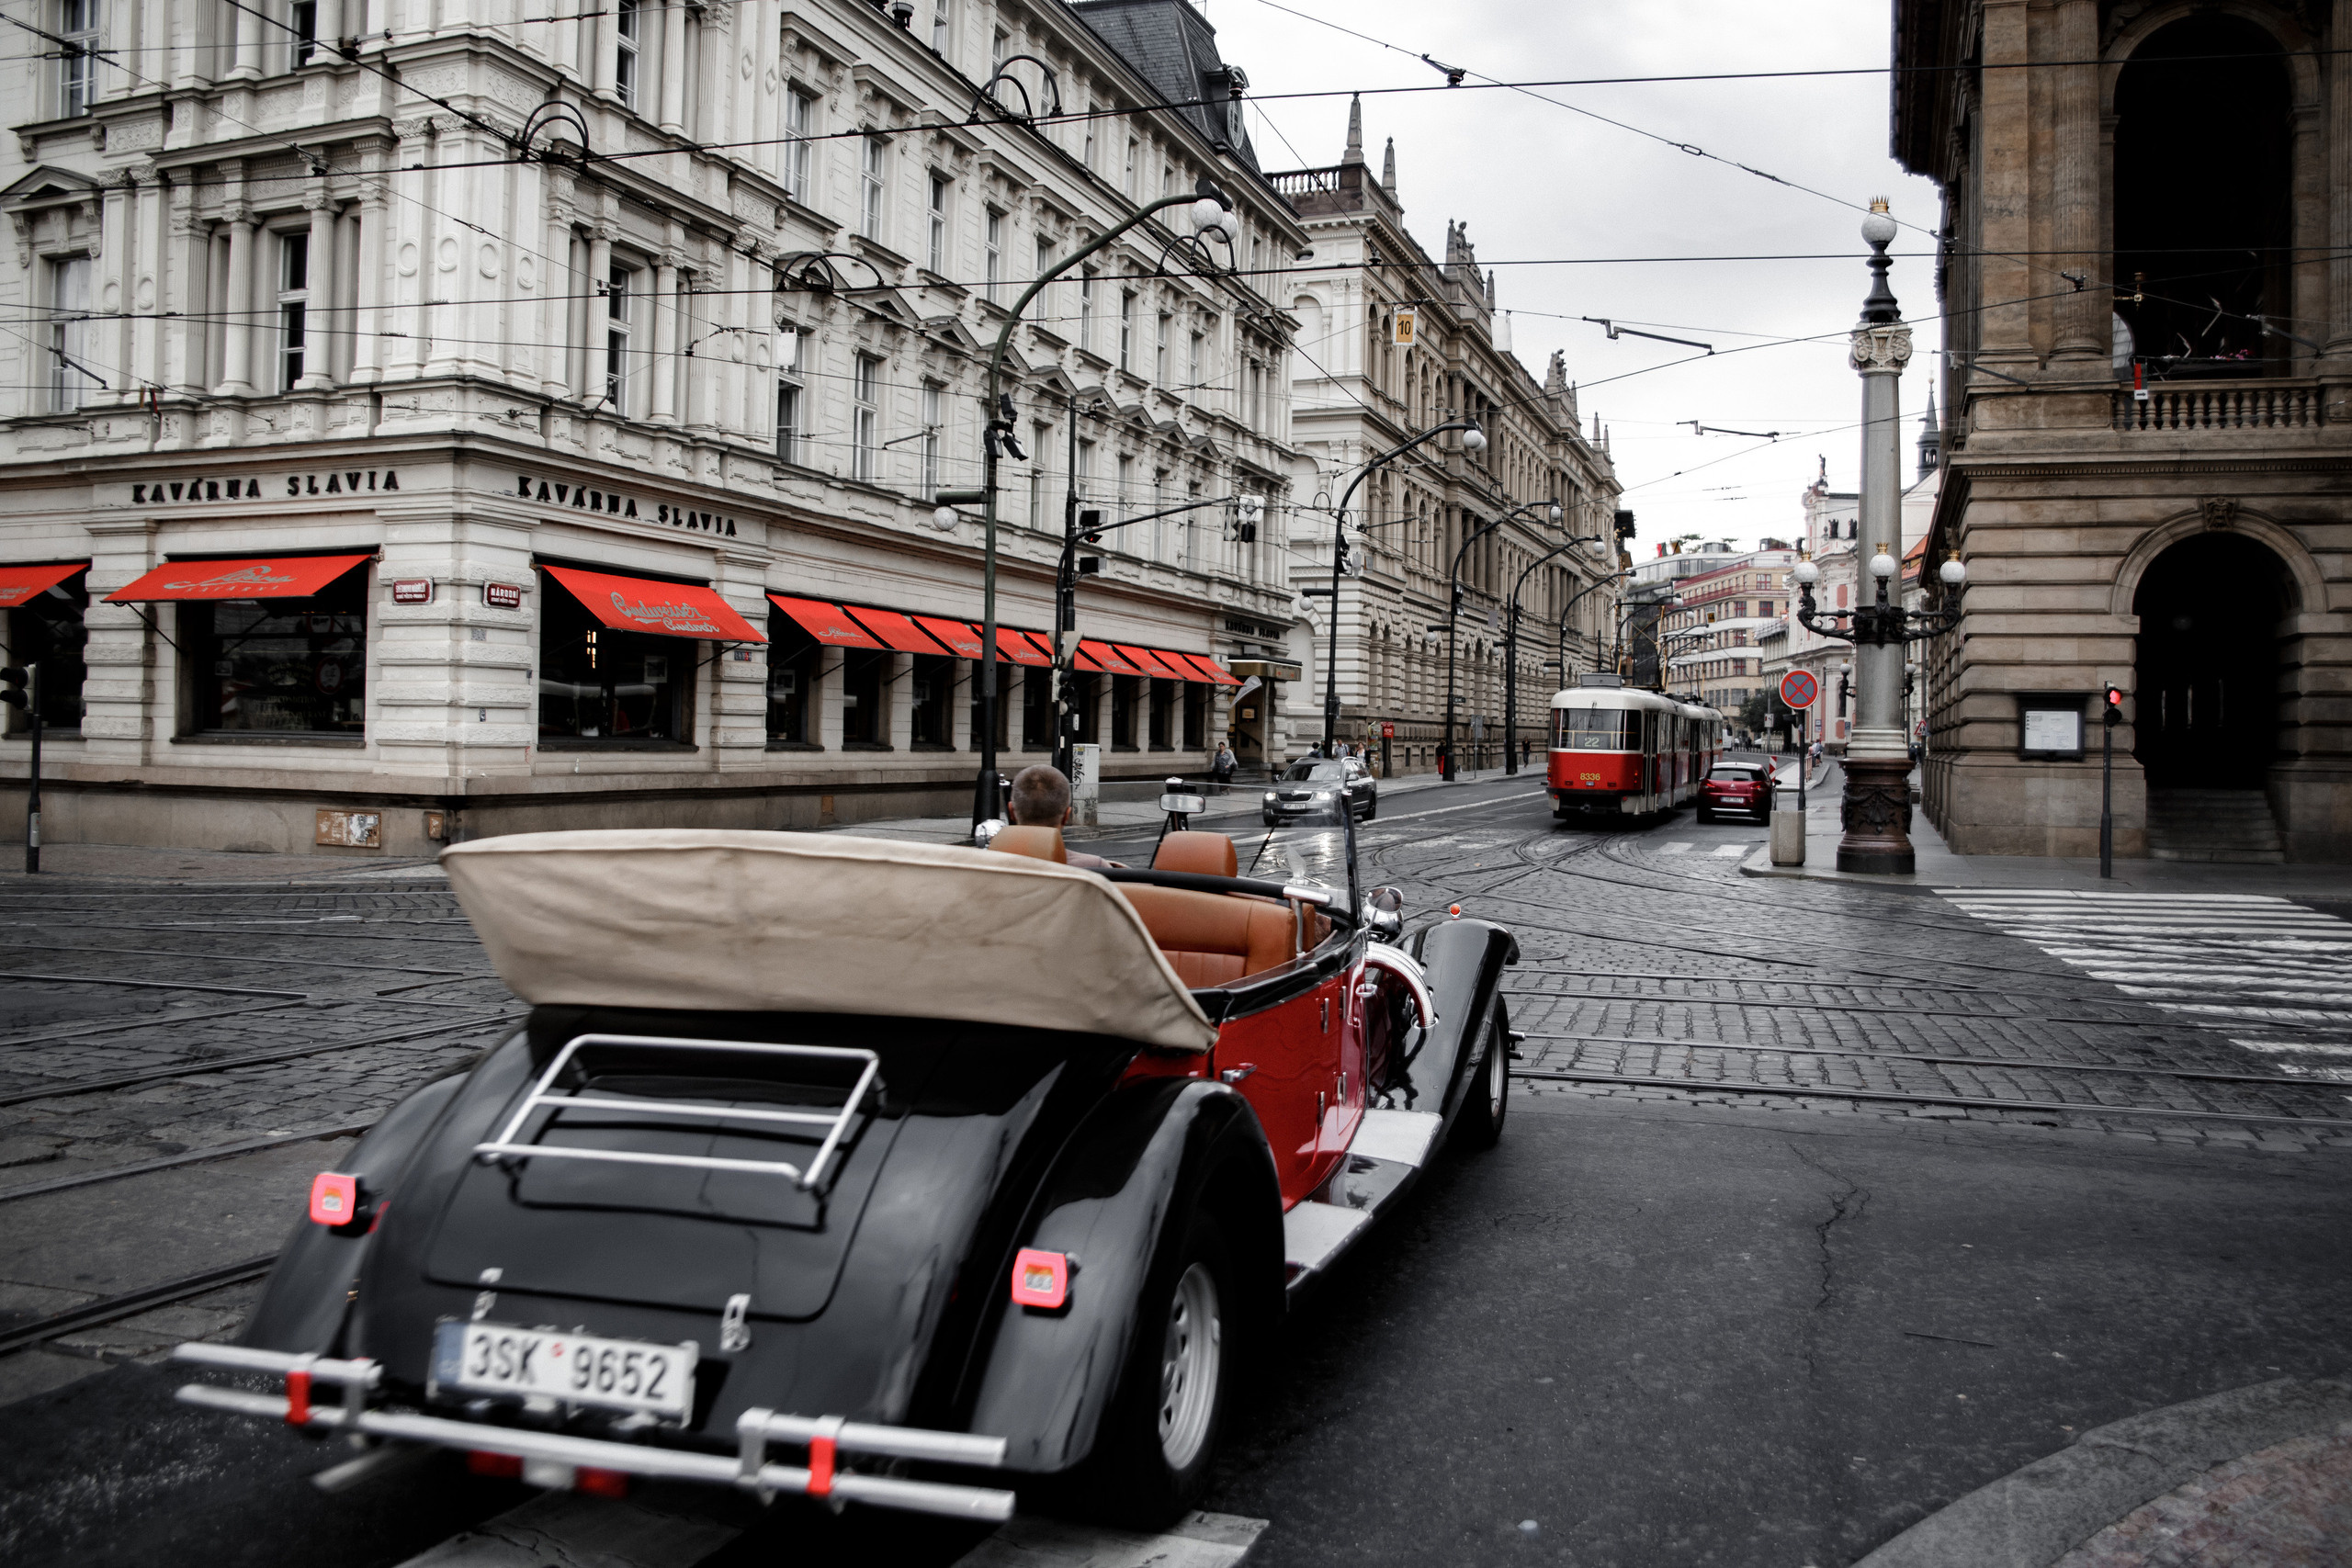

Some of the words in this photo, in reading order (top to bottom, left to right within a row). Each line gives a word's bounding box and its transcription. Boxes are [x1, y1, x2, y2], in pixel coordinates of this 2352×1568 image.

[1398, 321, 1411, 335] 10
[132, 478, 261, 503] KAVÁRNA
[288, 470, 400, 496] SLAVIA
[518, 476, 638, 518] KAVÁRNA
[658, 504, 737, 537] SLAVIA
[491, 586, 519, 599] NÁRODNÍ
[610, 592, 711, 624] Budweiser
[1584, 737, 1600, 747] 22
[1580, 773, 1600, 781] 8336
[469, 1334, 542, 1383] 3SK
[571, 1344, 668, 1401] 9652
